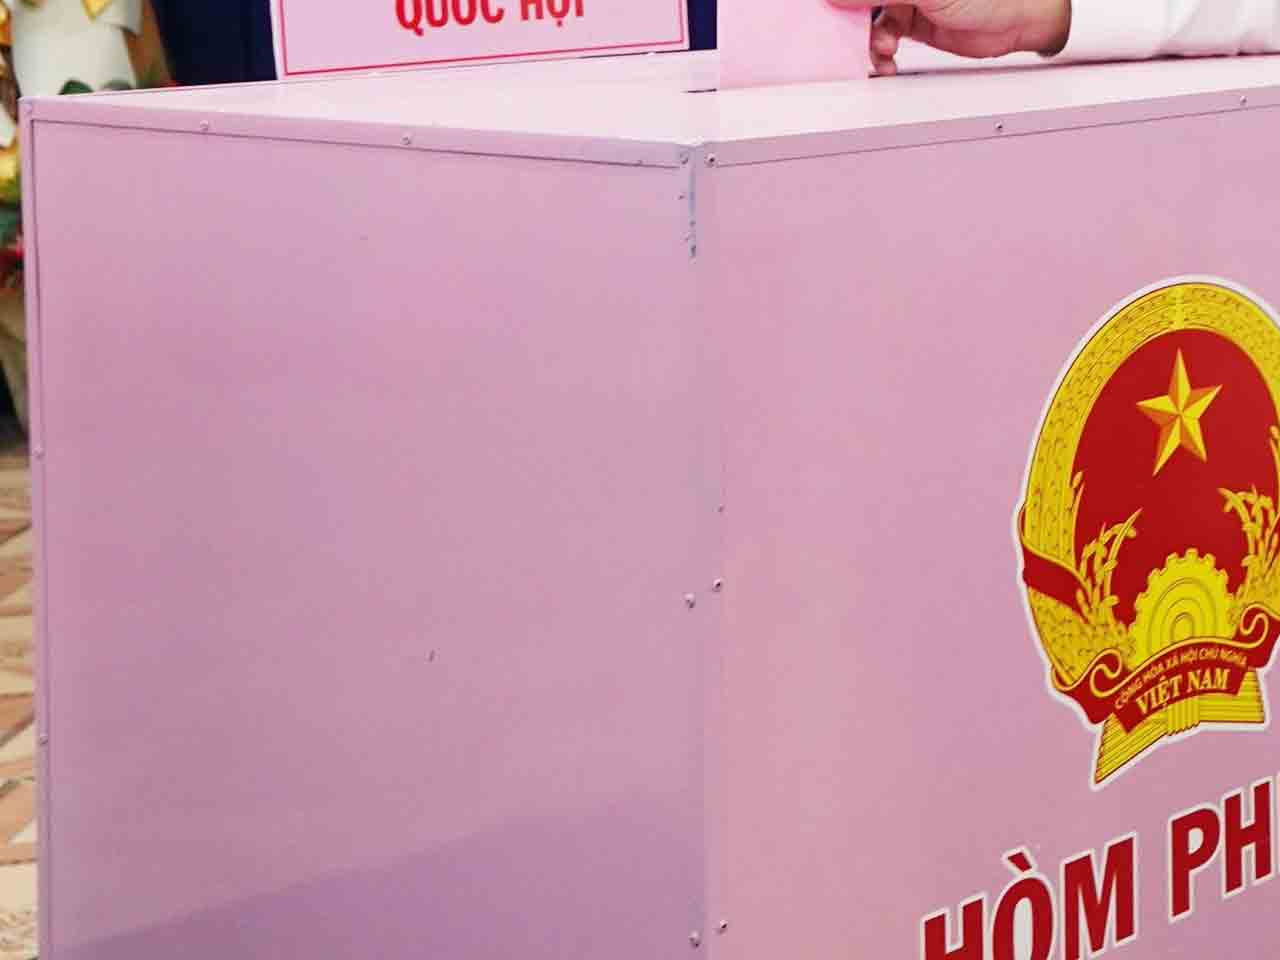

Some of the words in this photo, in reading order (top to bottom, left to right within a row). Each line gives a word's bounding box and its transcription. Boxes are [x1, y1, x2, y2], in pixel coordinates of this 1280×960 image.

[1135, 675, 1182, 715] VIỆT
[1185, 667, 1231, 694] NAM
[922, 836, 1136, 960] HÒM
